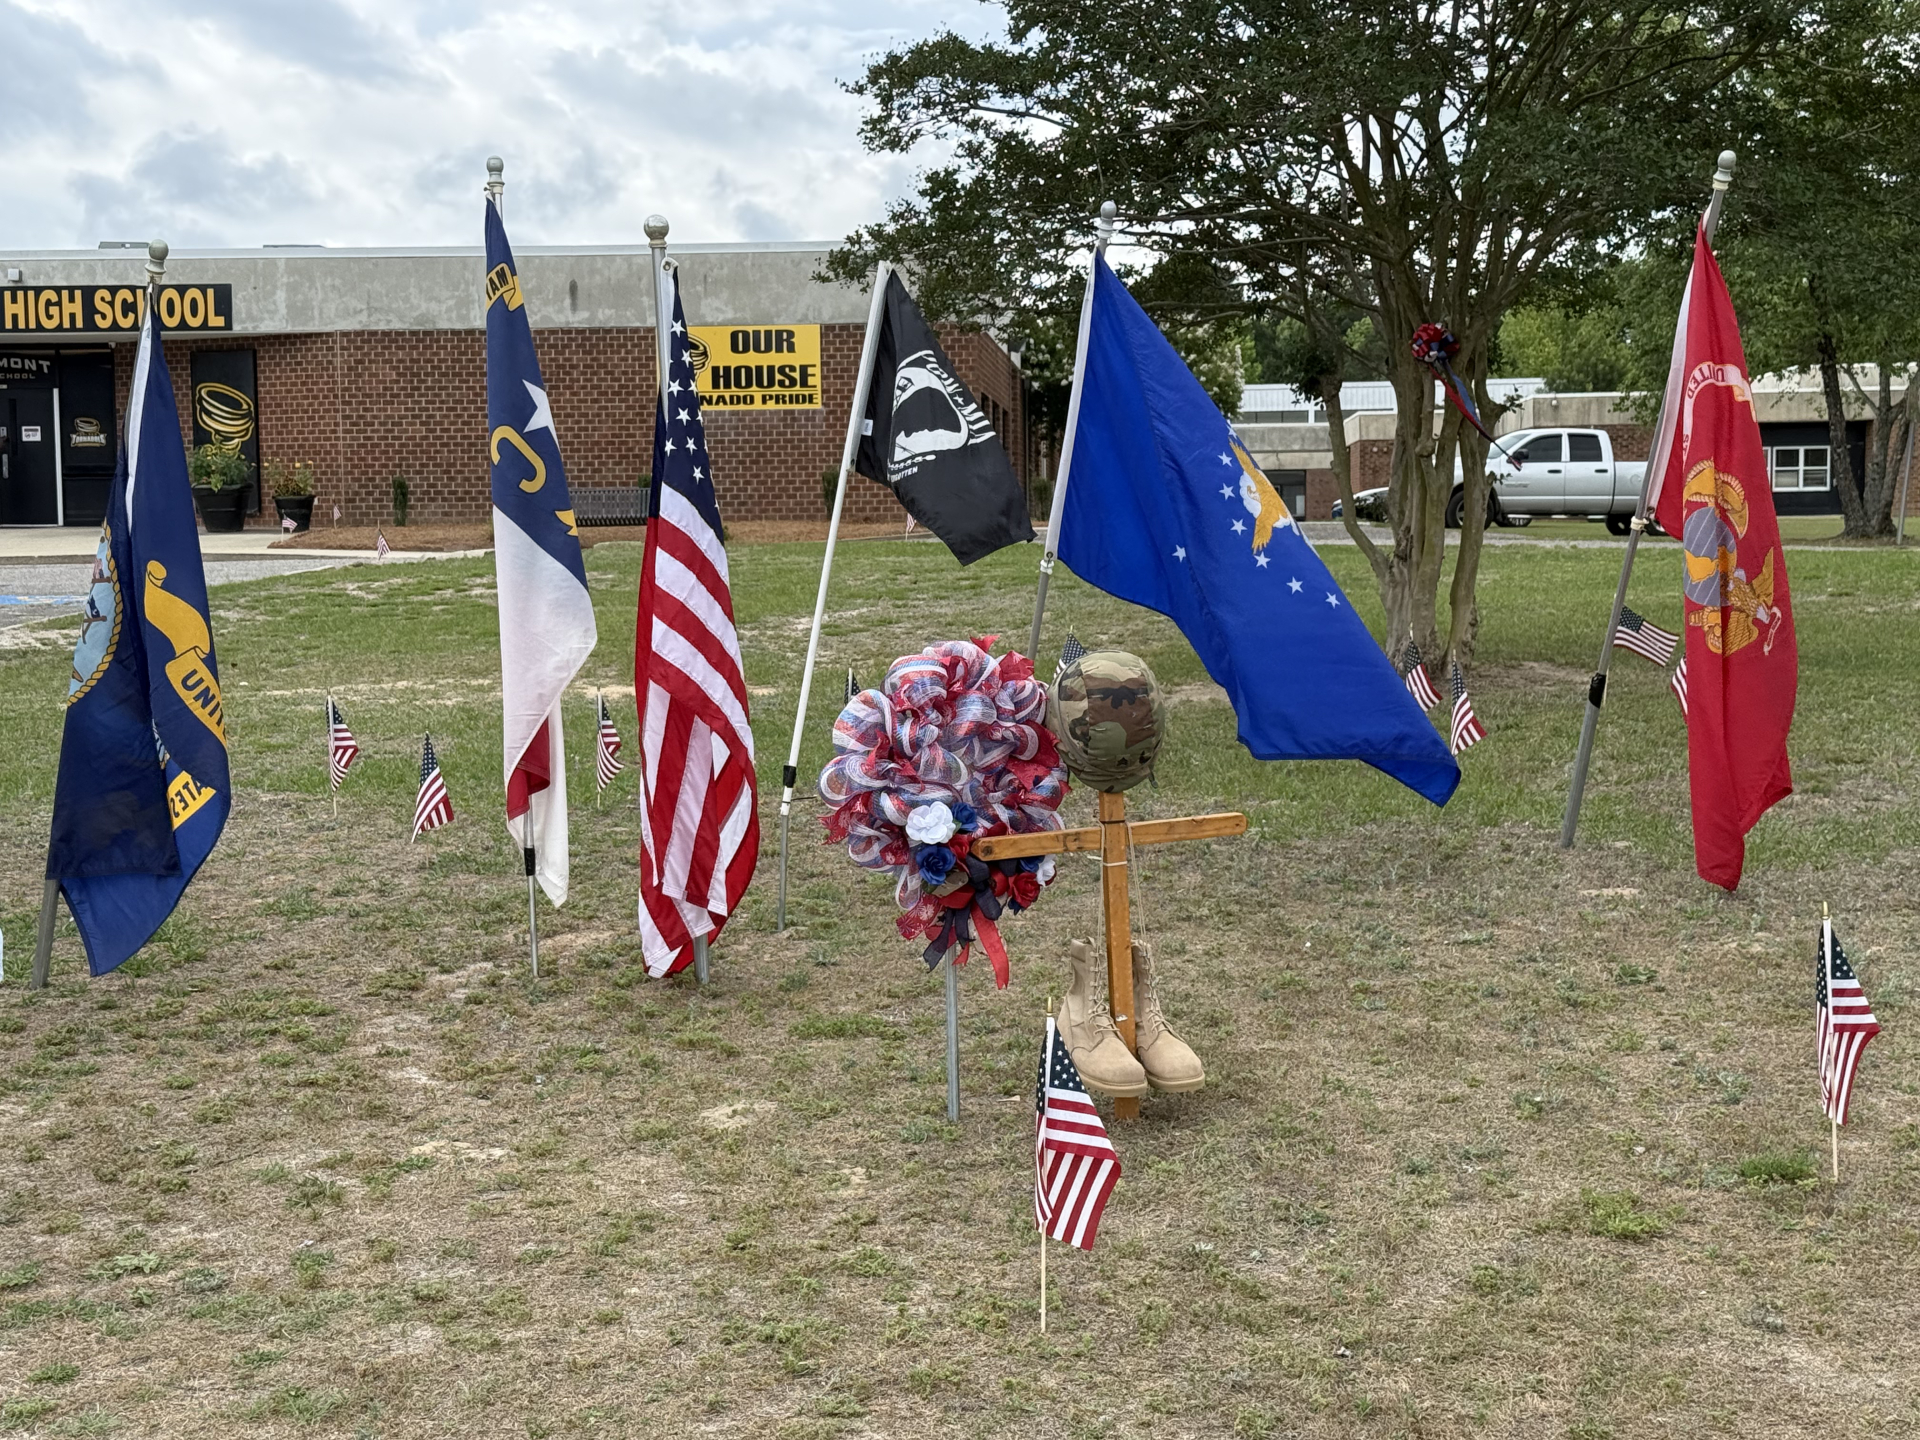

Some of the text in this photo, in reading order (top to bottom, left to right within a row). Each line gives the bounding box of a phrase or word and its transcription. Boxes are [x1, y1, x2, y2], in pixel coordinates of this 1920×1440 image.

[4, 288, 226, 329] HIGH SCOOL
[730, 329, 796, 354] OUR
[711, 364, 818, 390] HOUSE
[761, 393, 819, 406] PRIDE
